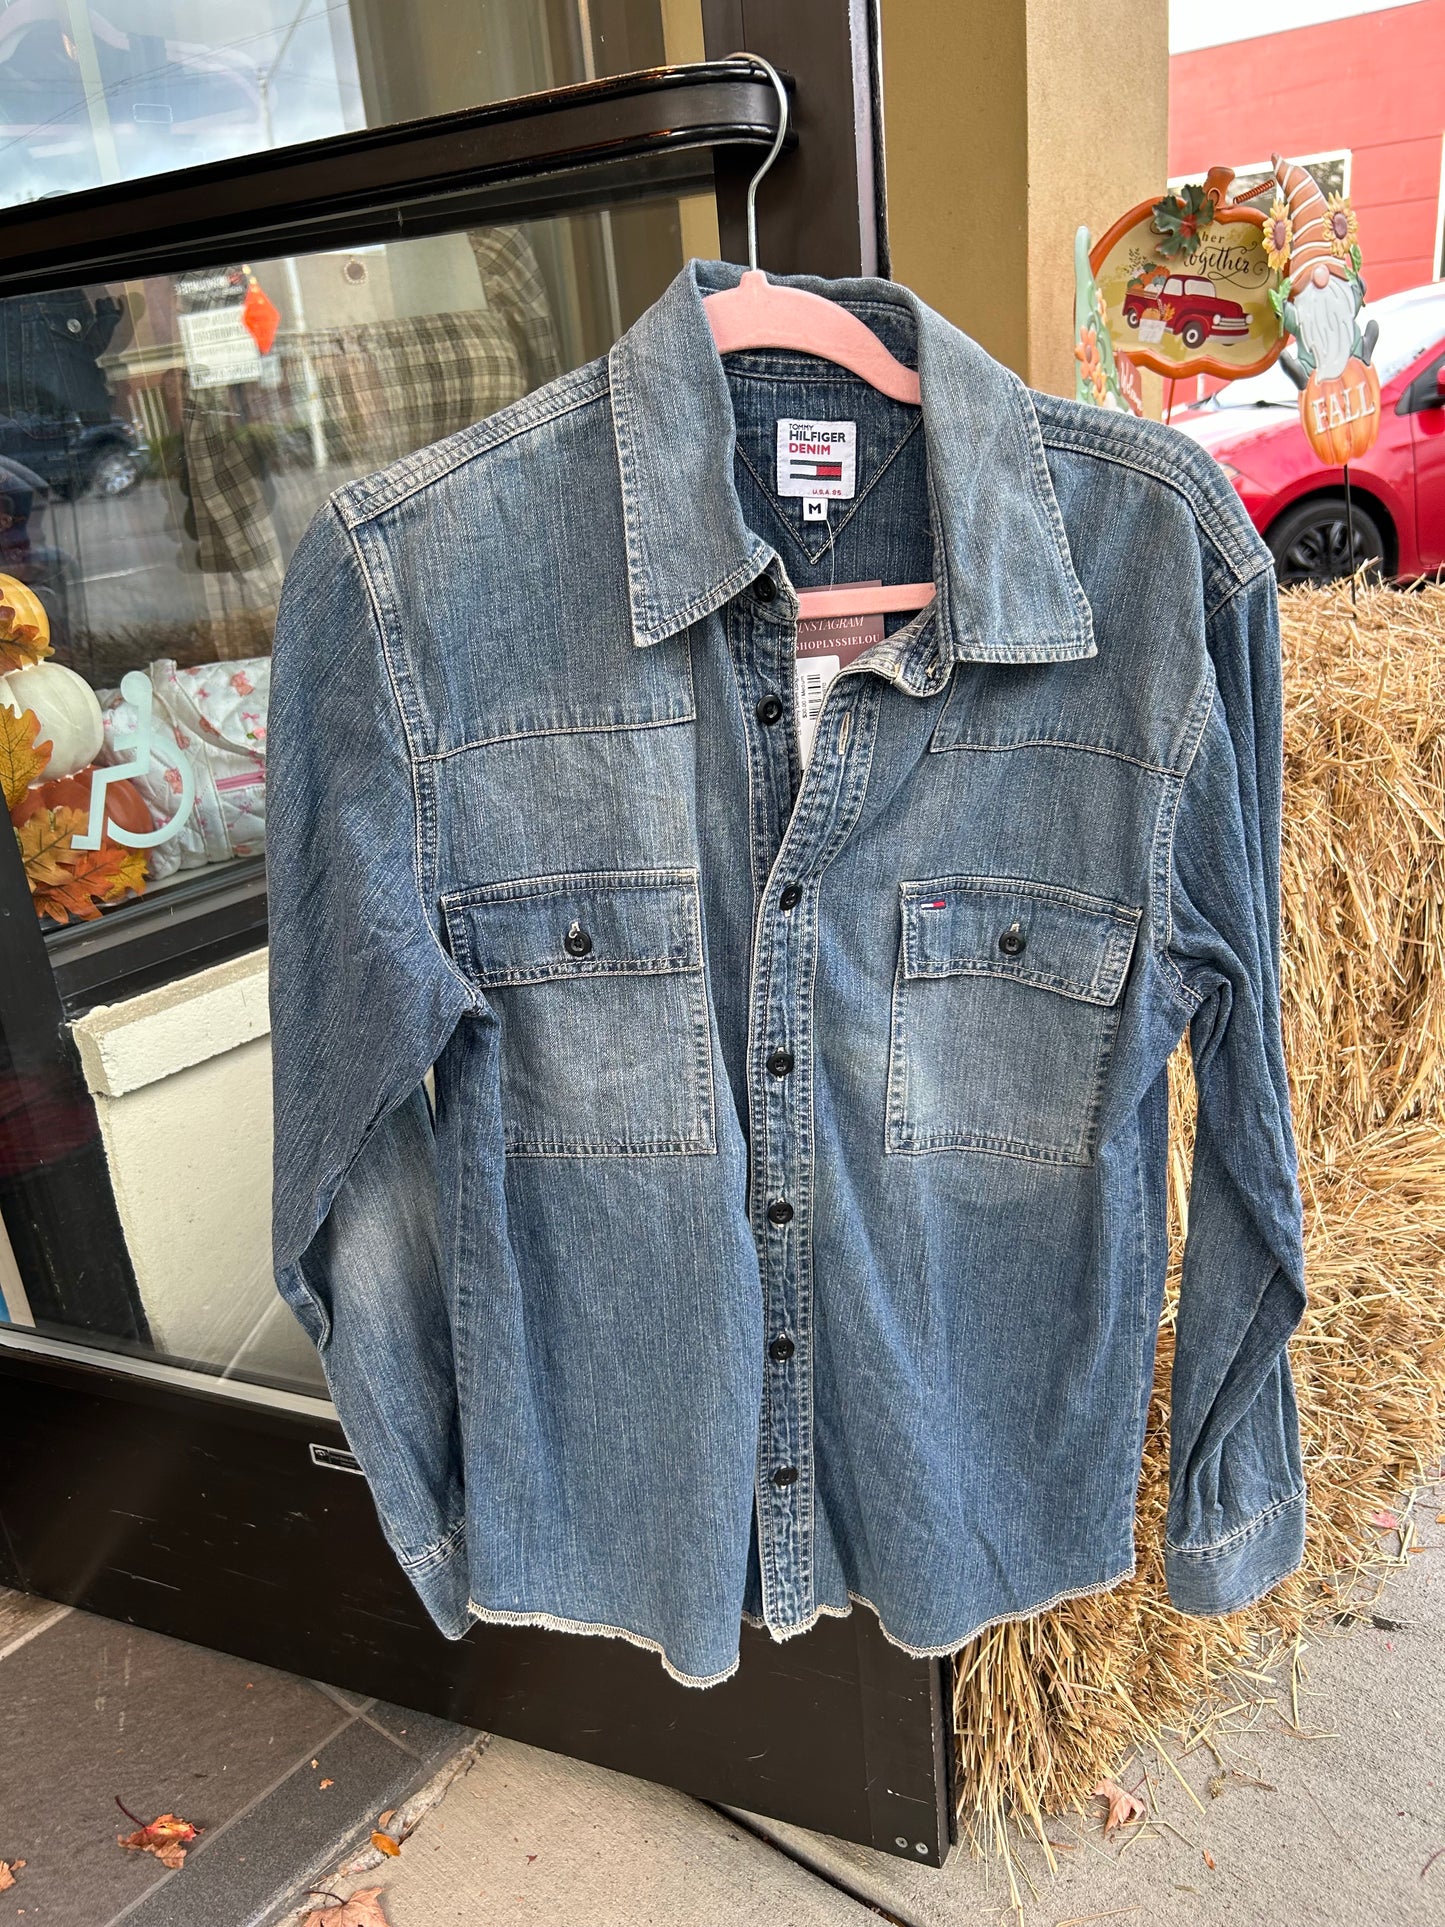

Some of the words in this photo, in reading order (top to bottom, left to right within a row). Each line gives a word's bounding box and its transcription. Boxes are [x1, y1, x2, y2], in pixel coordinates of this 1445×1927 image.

[1312, 381, 1376, 435] FALL
[789, 423, 814, 431] TOMMY
[789, 430, 846, 443] HILFIGER
[788, 443, 831, 455] DENIM
[808, 503, 821, 514] M
[798, 616, 864, 633] INSTAGRAM
